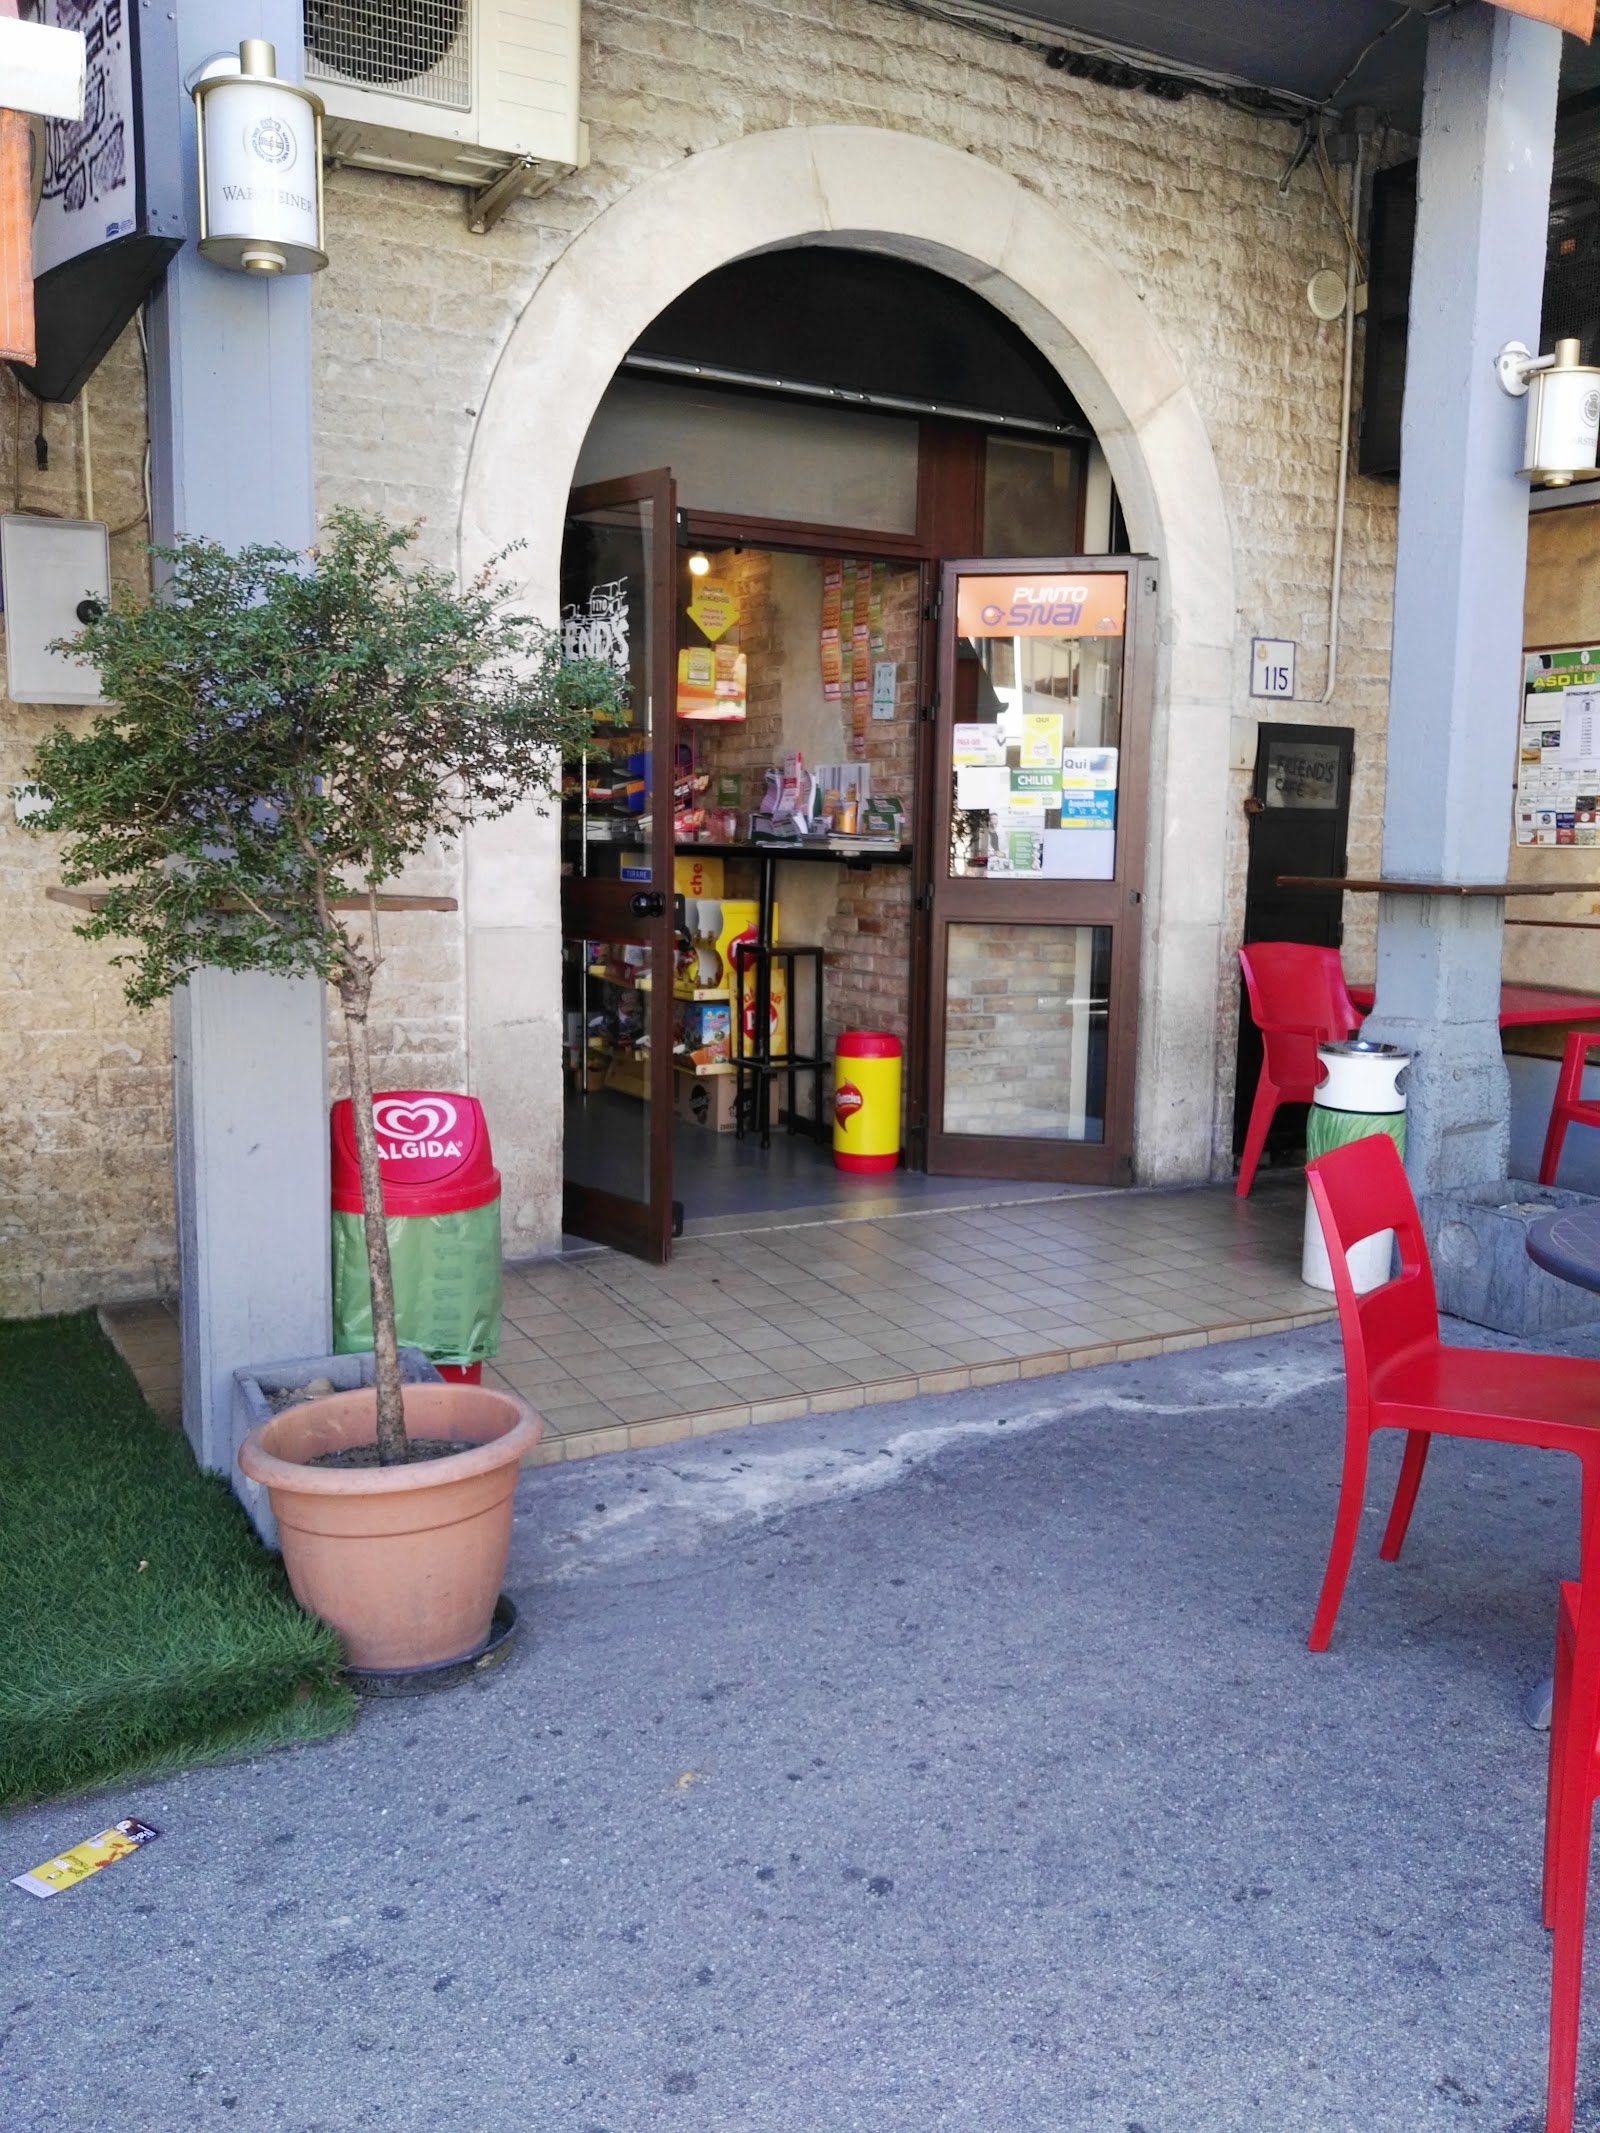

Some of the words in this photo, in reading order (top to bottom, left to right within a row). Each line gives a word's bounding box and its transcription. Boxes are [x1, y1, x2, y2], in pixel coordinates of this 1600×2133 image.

[222, 185, 314, 215] WAREINER
[1012, 585, 1089, 604] PUNTO
[1265, 666, 1289, 691] 115
[1533, 674, 1571, 688] ASD
[1573, 672, 1600, 685] LU
[1064, 759, 1087, 770] Qui
[626, 869, 648, 880] TIRARE
[378, 1140, 462, 1160] ALGIDA
